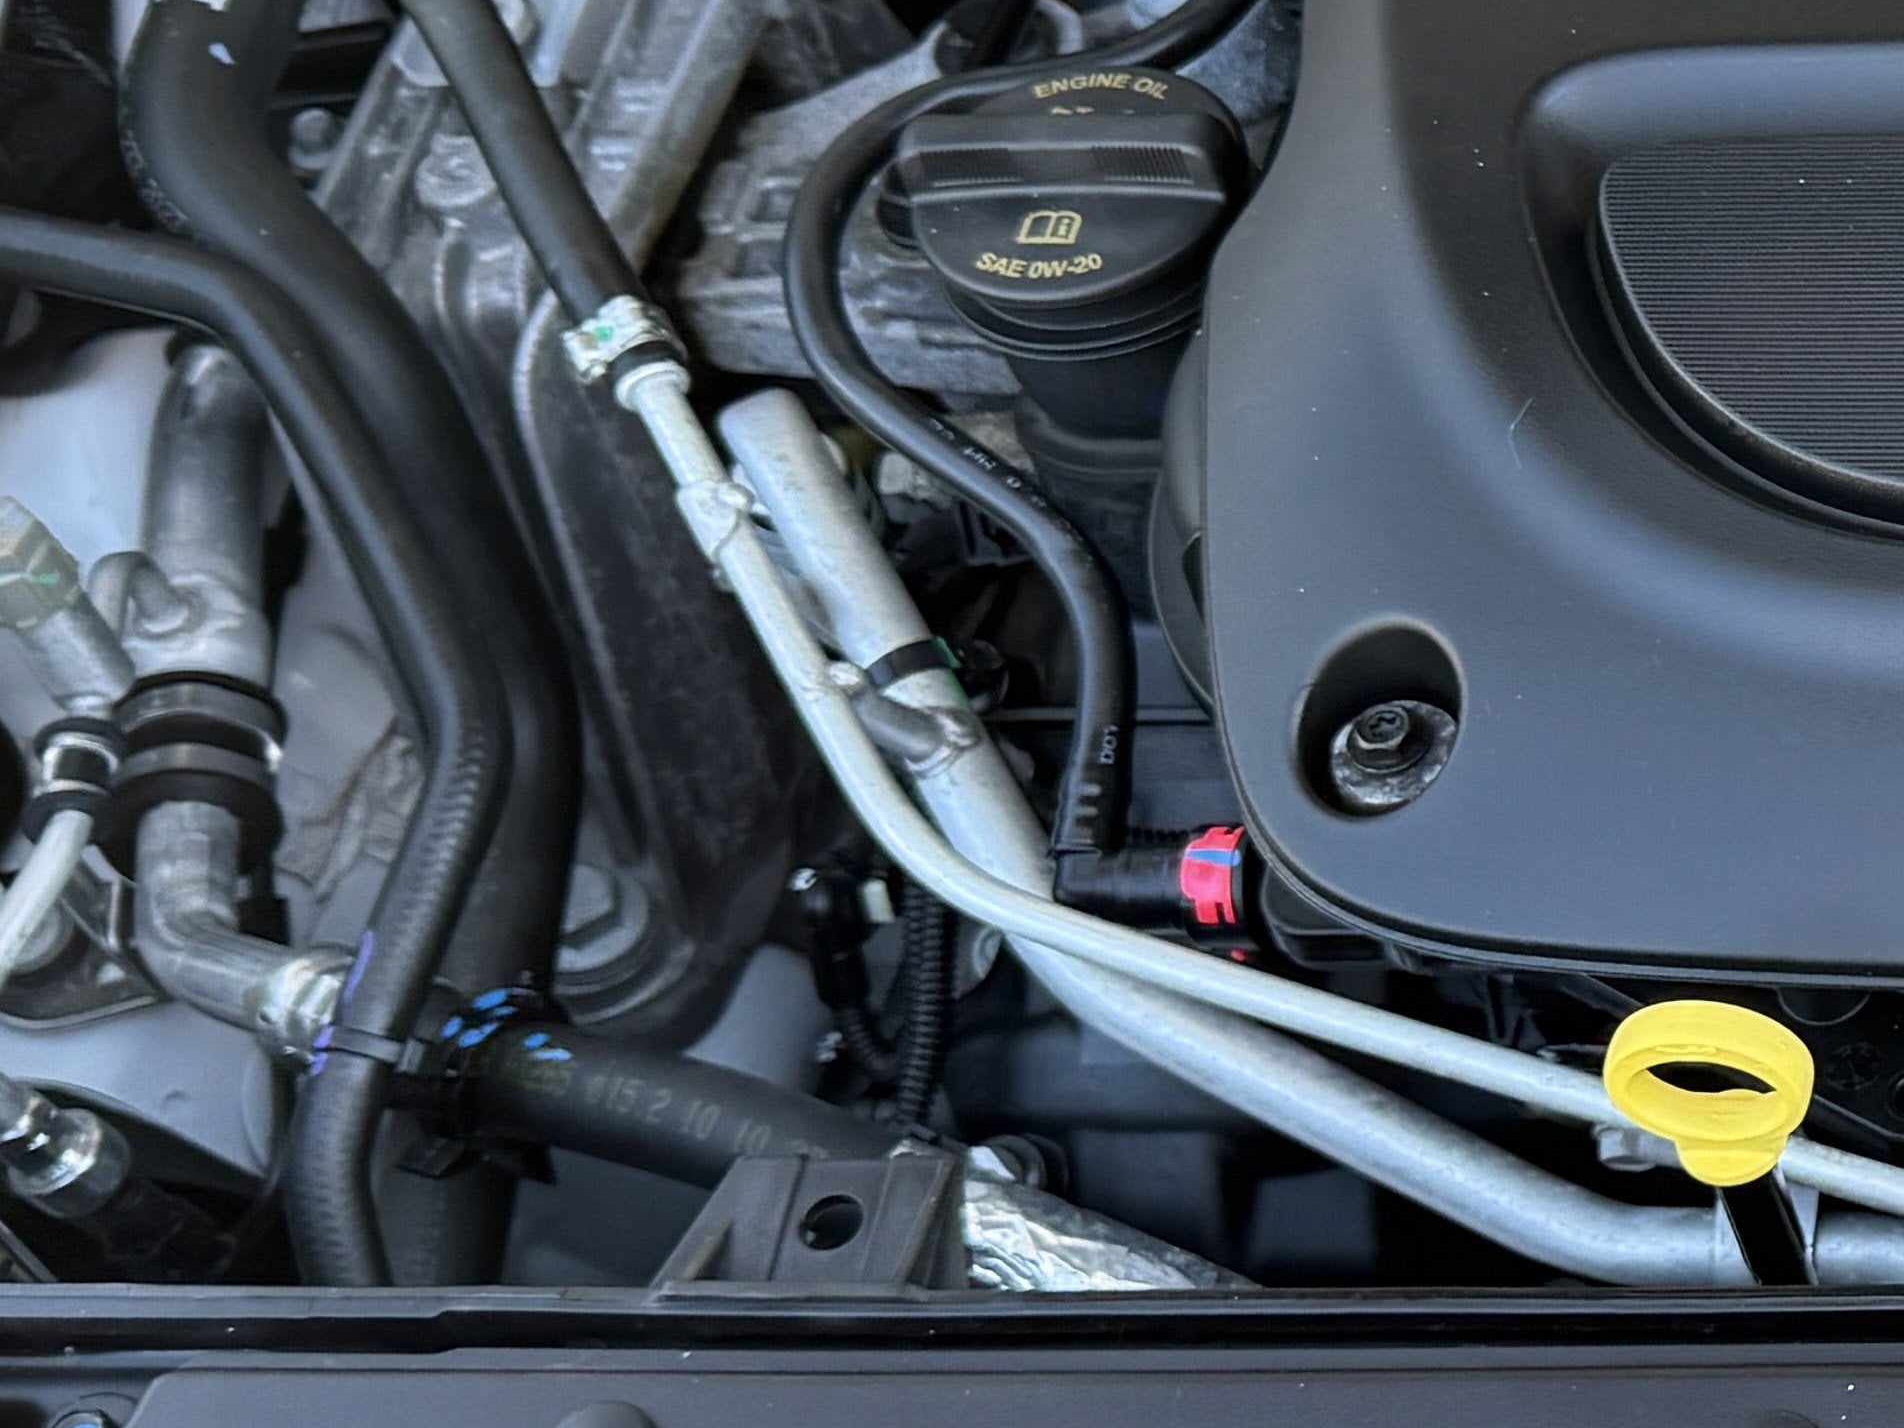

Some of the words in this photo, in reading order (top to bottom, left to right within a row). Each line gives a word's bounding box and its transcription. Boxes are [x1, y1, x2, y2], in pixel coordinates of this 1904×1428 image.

[1033, 72, 1132, 99] ENGINE
[1133, 77, 1169, 100] OIL
[975, 251, 1027, 278] SAE
[1028, 252, 1103, 280] 0W-20
